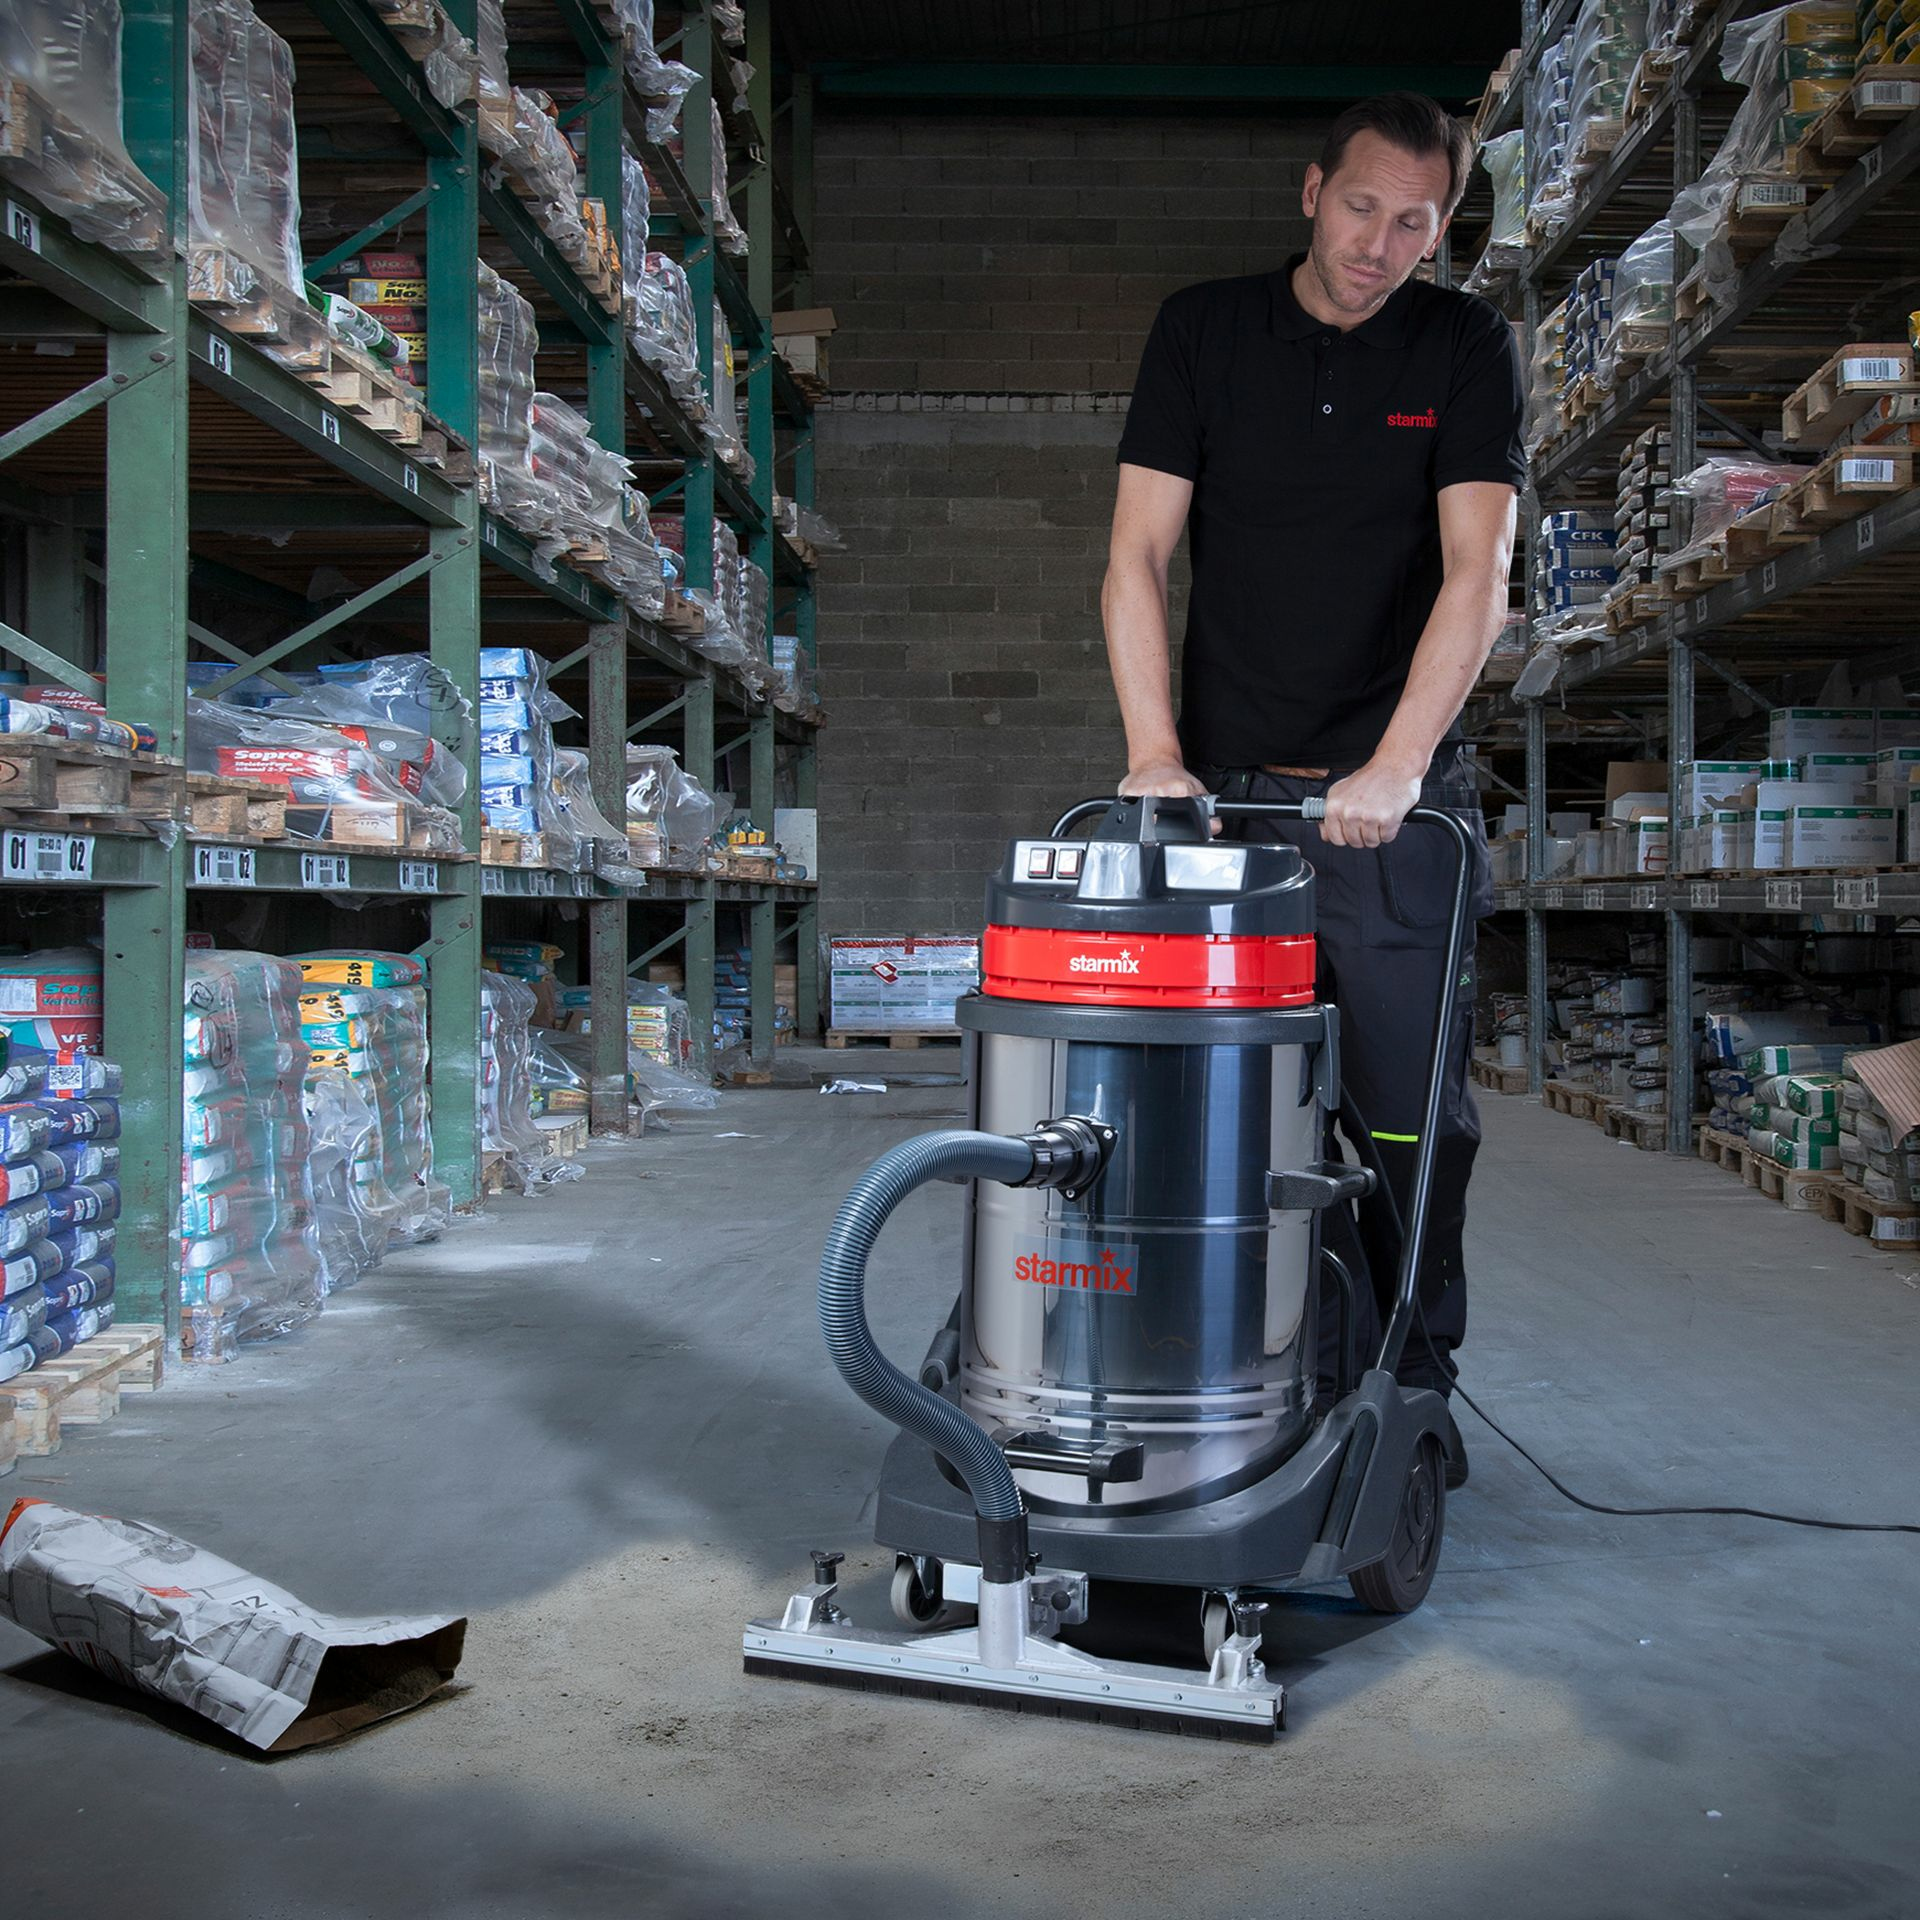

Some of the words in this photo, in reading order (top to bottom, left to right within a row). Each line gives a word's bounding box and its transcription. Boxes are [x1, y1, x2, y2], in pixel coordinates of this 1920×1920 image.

[15, 211, 32, 249] 03
[384, 289, 427, 298] No.
[1570, 531, 1604, 541] CFK
[1569, 569, 1602, 579] CFK
[234, 750, 304, 762] Sopro
[11, 837, 26, 869] 01
[70, 840, 85, 871] 02
[200, 850, 211, 877] 01
[239, 853, 250, 879] 02
[305, 858, 314, 881] 01
[1069, 949, 1140, 974] starmix
[347, 962, 362, 985] 419
[42, 983, 98, 996] Sop
[61, 1034, 89, 1043] VF
[76, 1045, 102, 1053] 41
[1015, 1247, 1133, 1292] starmix
